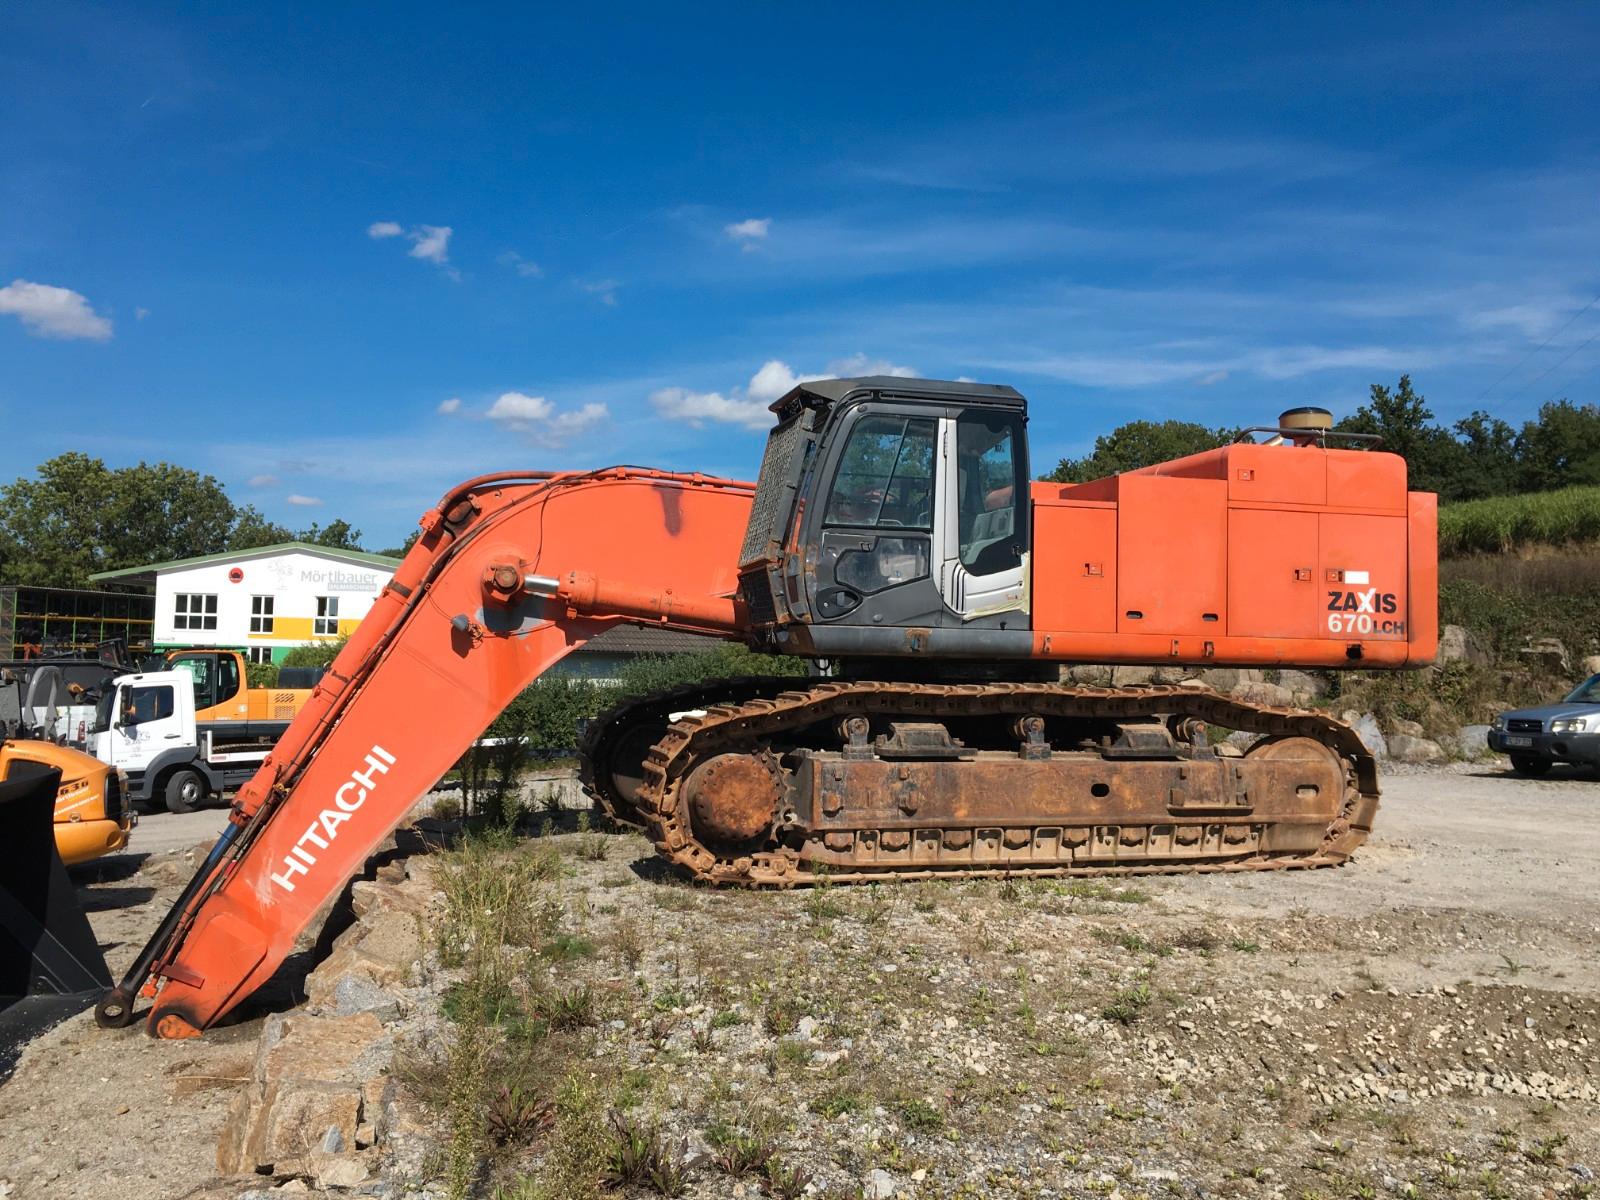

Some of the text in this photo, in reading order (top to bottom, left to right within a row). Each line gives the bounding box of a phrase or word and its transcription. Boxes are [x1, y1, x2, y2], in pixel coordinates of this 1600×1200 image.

[301, 570, 377, 583] Mörtlbauer
[1328, 587, 1397, 613] ZAXIS
[270, 744, 397, 892] HITACHI
